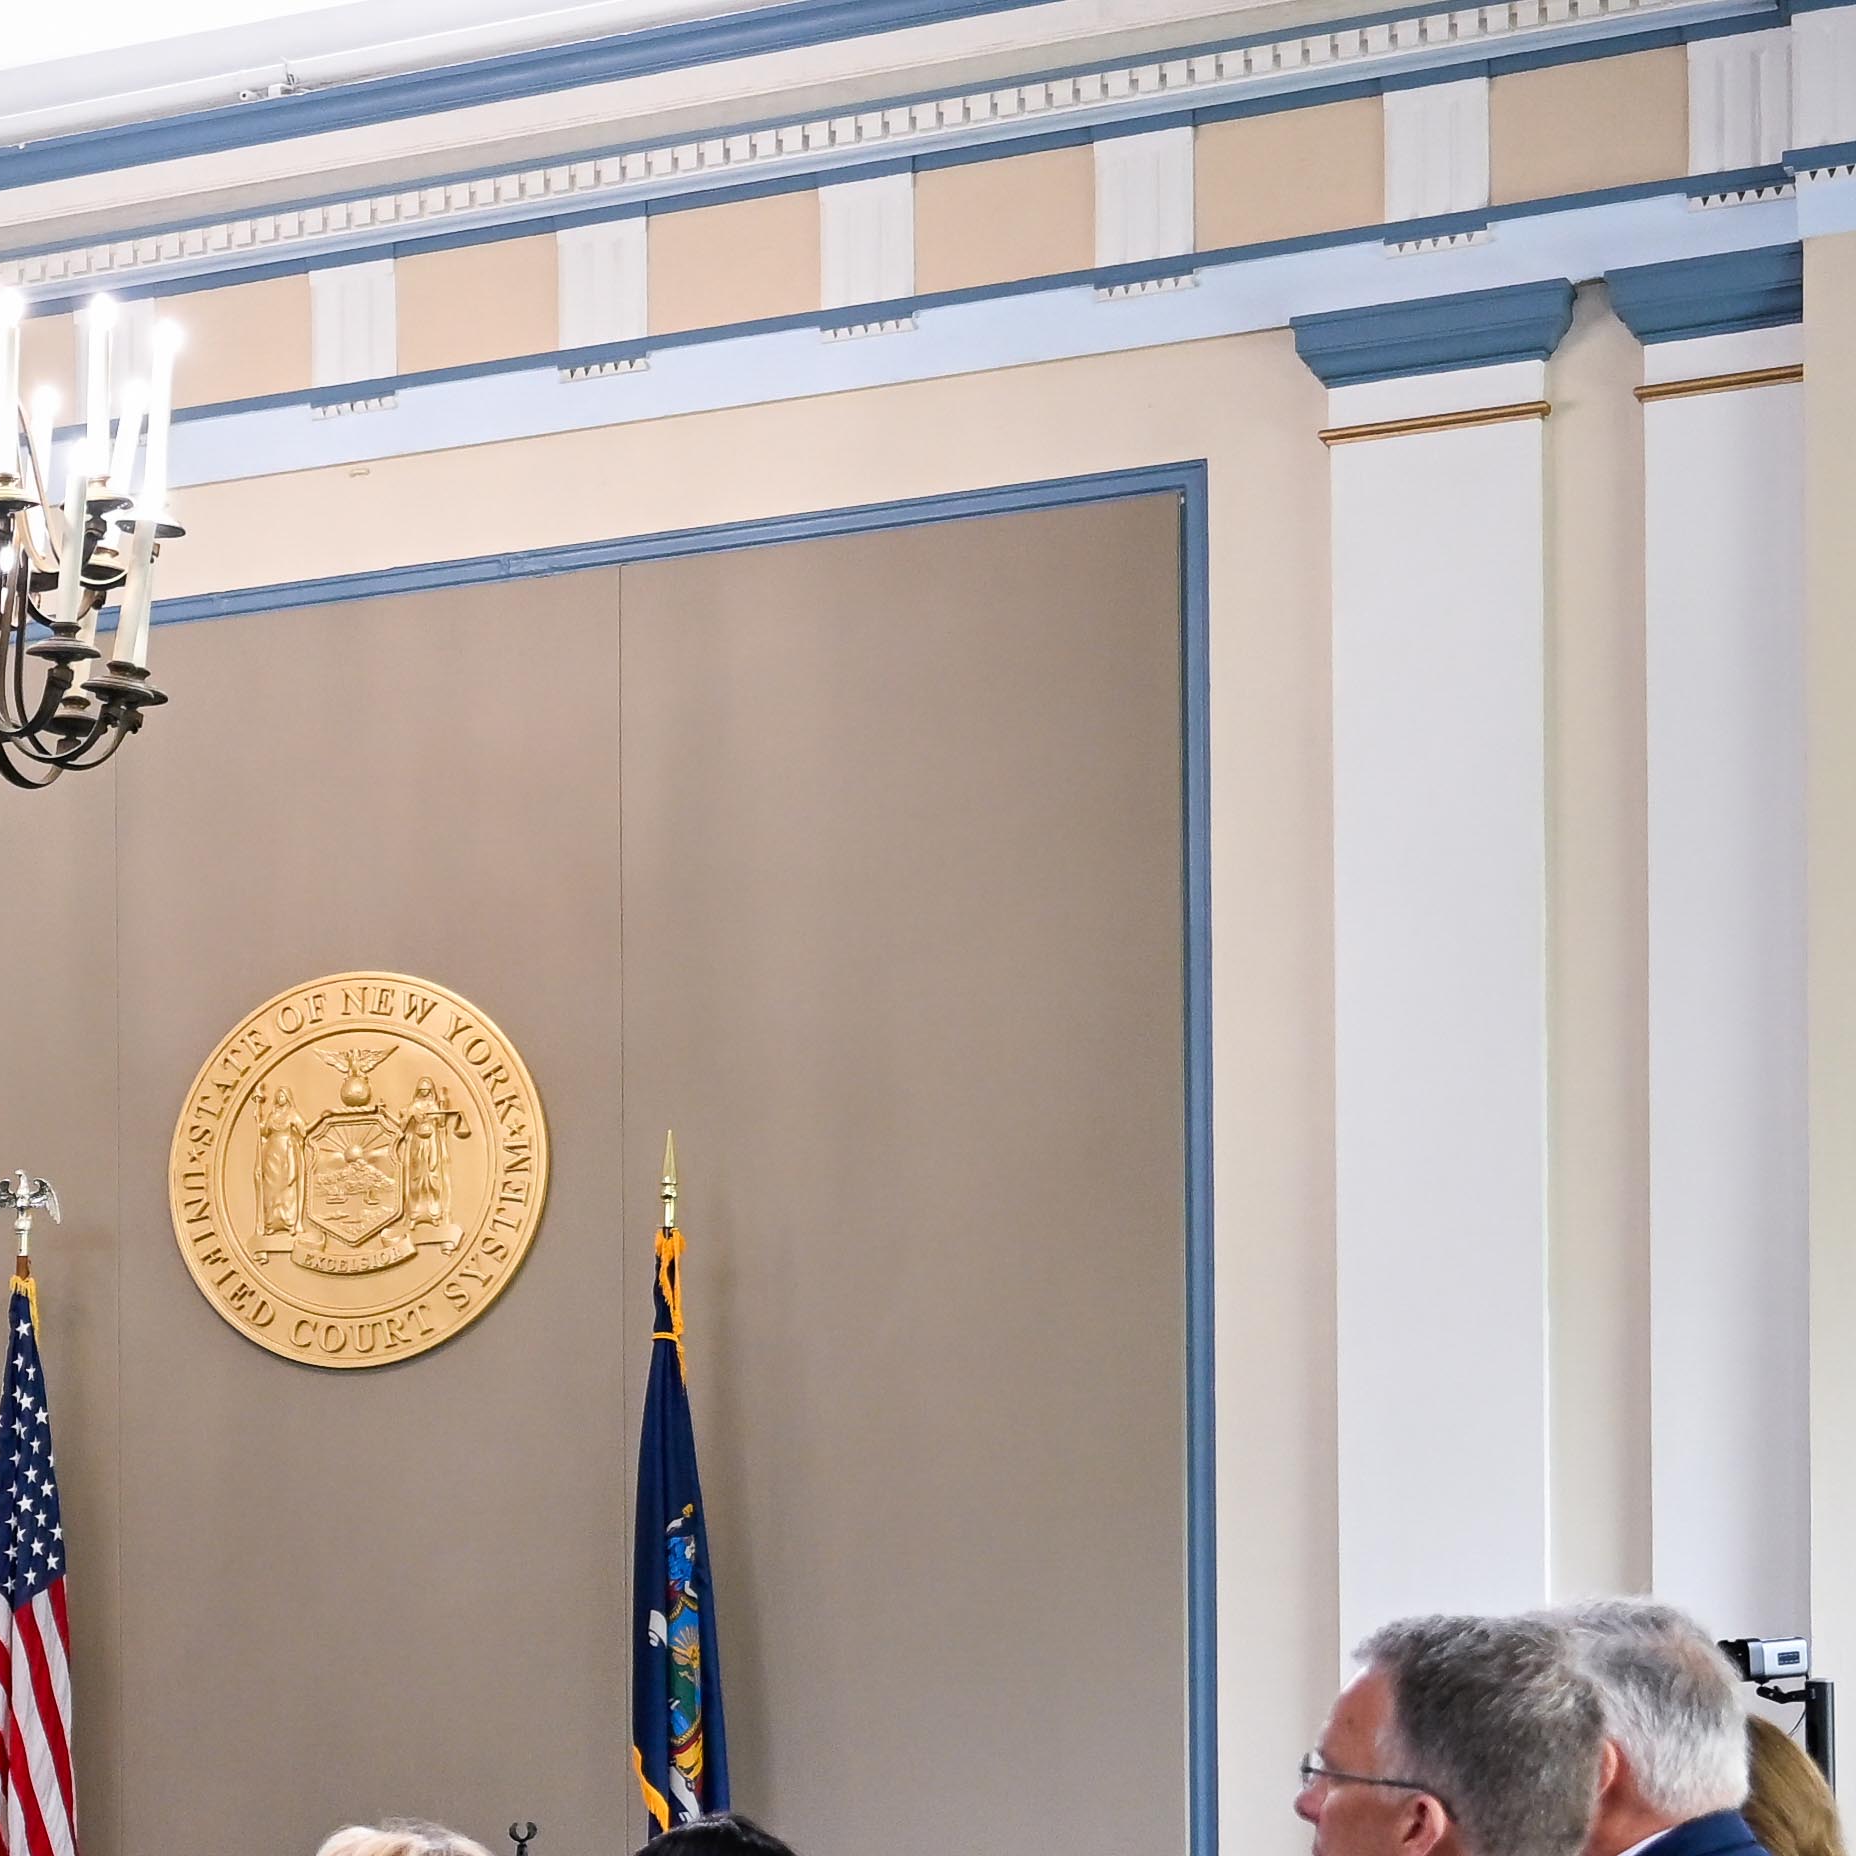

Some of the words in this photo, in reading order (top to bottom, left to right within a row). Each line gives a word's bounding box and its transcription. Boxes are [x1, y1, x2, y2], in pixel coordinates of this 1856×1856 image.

[190, 1030, 272, 1146] STATE
[276, 996, 327, 1034] OF
[342, 987, 437, 1025] NEW
[442, 1015, 526, 1118] YORK
[183, 1164, 276, 1329] UNIFIED
[290, 1303, 435, 1353] COURT
[443, 1137, 533, 1311] SYSTEM
[302, 1248, 403, 1272] EXCELSIOR
